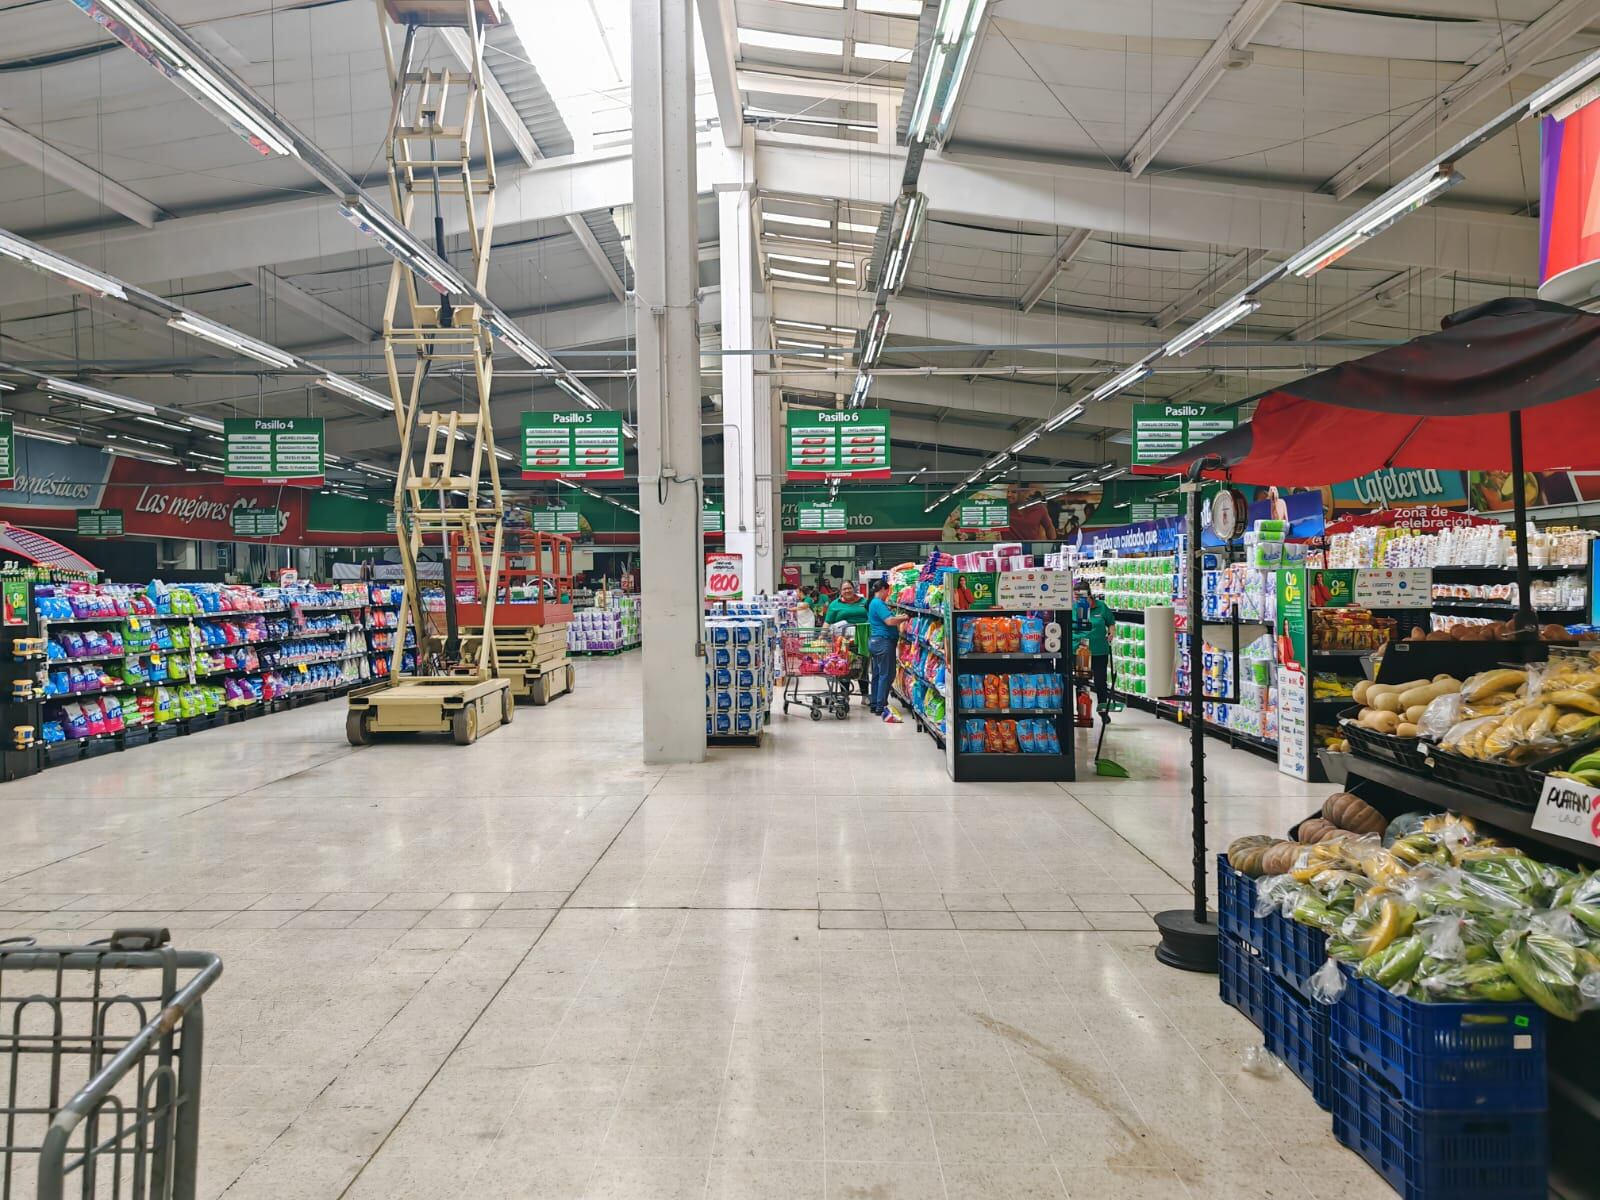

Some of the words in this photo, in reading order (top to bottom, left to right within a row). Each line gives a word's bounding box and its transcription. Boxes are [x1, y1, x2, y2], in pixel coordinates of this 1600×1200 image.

[818, 411, 850, 422] Pasillo
[851, 412, 859, 422] 6
[1165, 405, 1198, 416] Pasillo
[1199, 406, 1206, 416] 7
[552, 412, 584, 423] Pasillo
[585, 413, 593, 423] 5
[255, 419, 286, 430] Pasillo
[286, 420, 294, 430] 4
[135, 485, 169, 515] Las
[167, 495, 230, 525] mejores
[1394, 507, 1428, 518] Zona
[1430, 505, 1449, 517] de
[1393, 515, 1473, 529] celebración
[1120, 527, 1144, 549] cuidado
[1144, 529, 1158, 549] que
